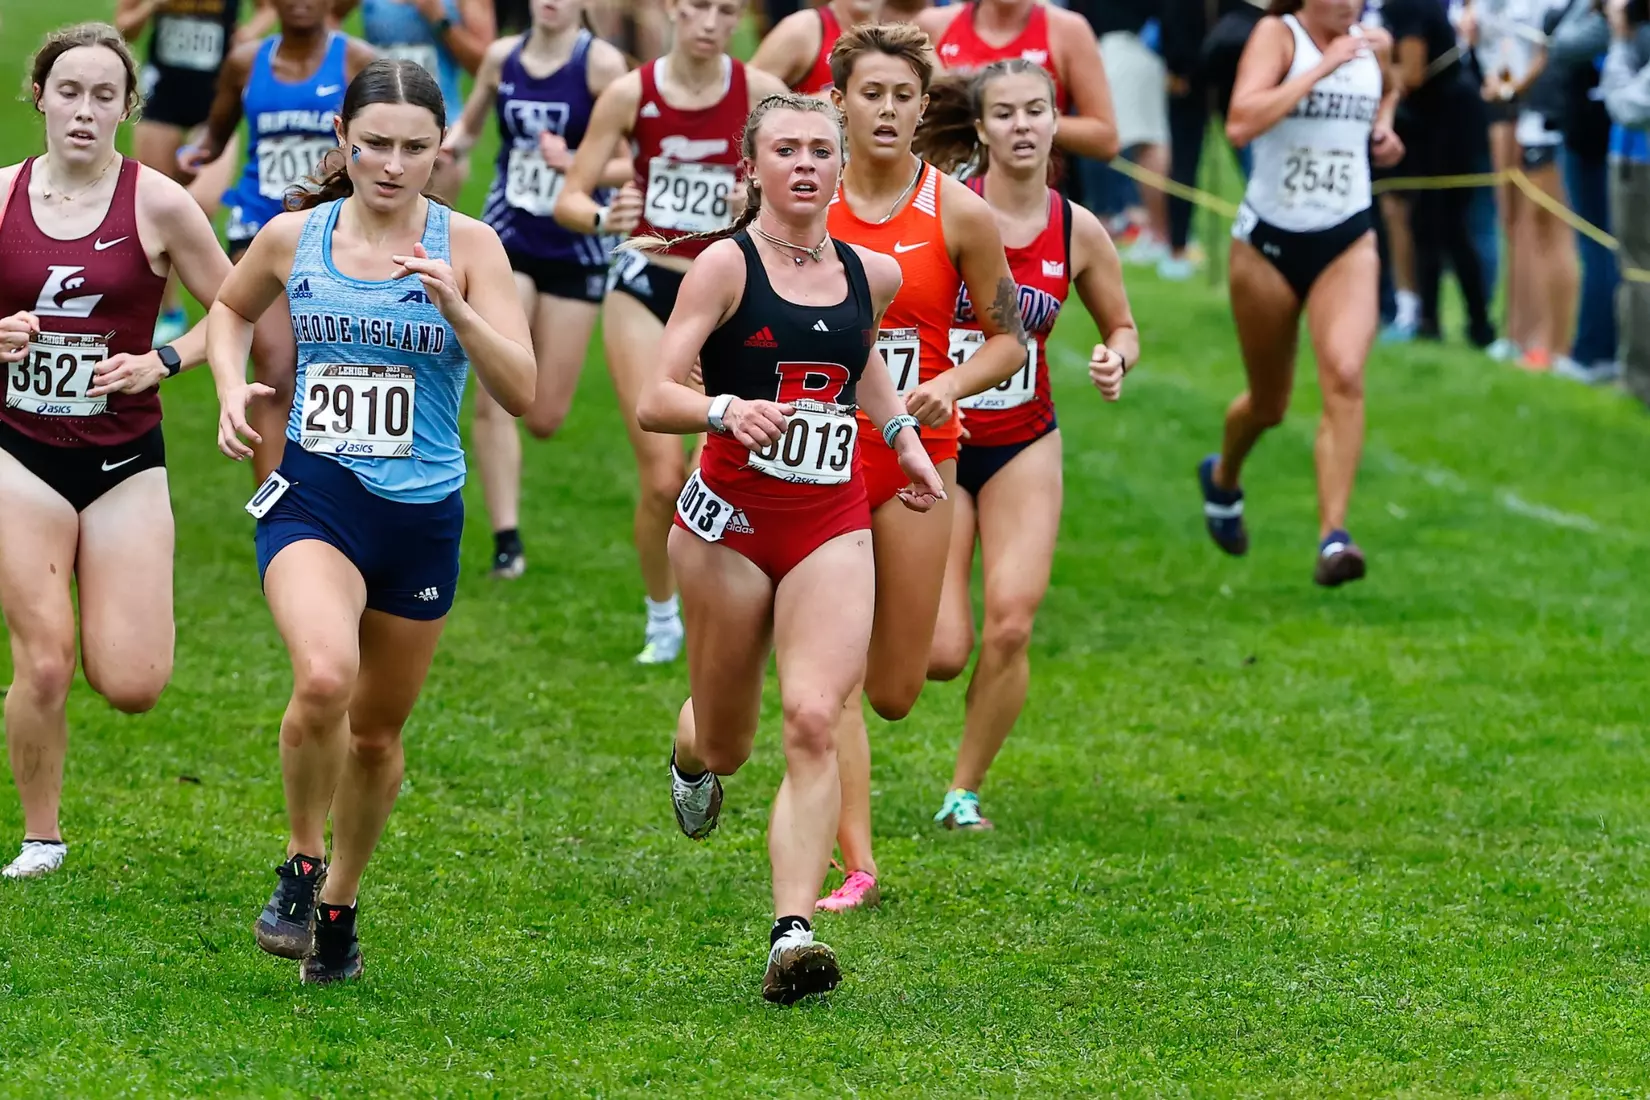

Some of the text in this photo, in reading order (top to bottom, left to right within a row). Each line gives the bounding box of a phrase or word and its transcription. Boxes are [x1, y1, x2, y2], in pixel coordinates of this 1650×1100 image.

[1283, 156, 1351, 196] 2545
[651, 175, 729, 217] 2928
[37, 334, 66, 345] LEHIGH
[291, 314, 446, 355] RHODE ISLAND
[743, 339, 779, 348] adidas
[12, 350, 104, 398] 3527
[338, 366, 370, 376] LEHIGH
[775, 361, 851, 404] R
[47, 404, 72, 414] asics
[305, 384, 410, 437] 2910
[347, 443, 374, 453] asics
[726, 522, 755, 534] didas
